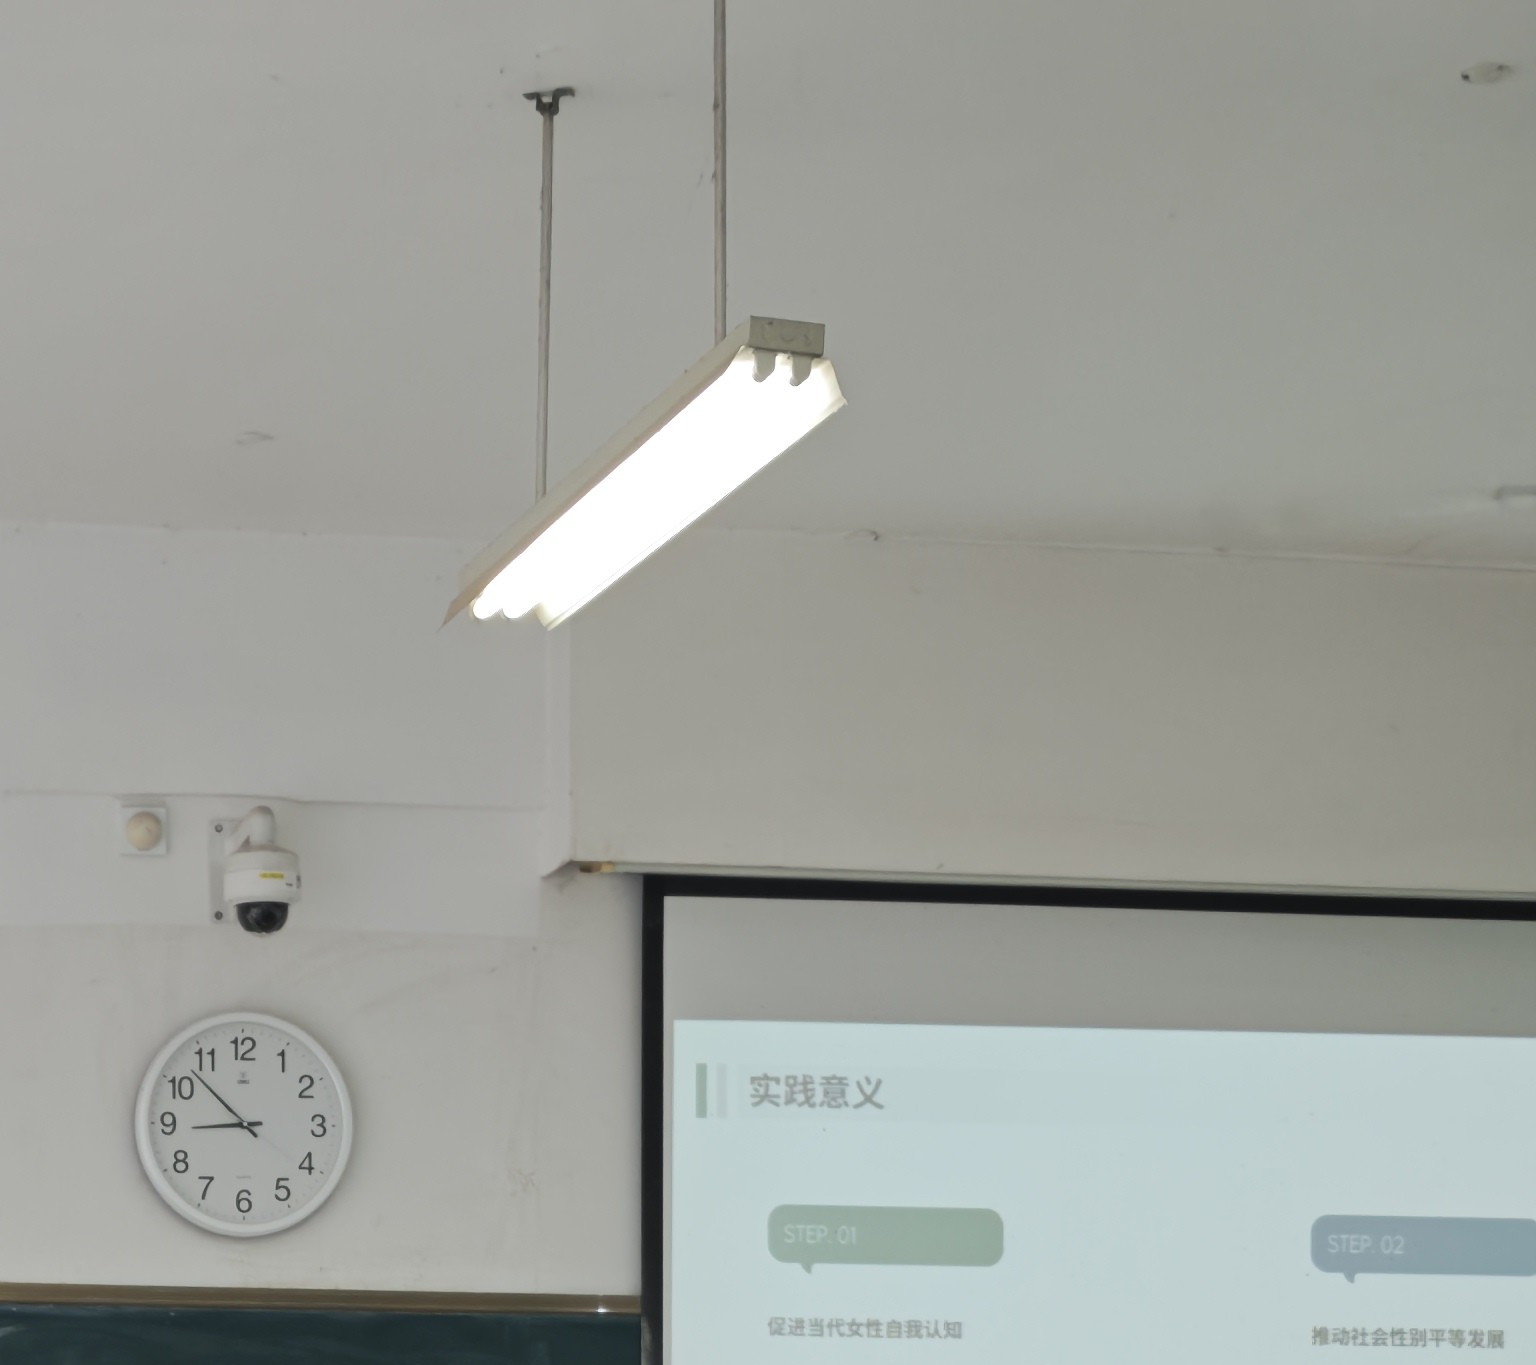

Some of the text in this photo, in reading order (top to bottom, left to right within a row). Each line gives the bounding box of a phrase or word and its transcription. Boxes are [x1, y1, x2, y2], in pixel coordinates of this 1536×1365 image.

[194, 1048, 215, 1071] 11
[230, 1036, 257, 1061] 12
[276, 1049, 286, 1073] 1
[168, 1076, 194, 1100] 10
[298, 1075, 315, 1099] 2
[749, 1073, 885, 1110] 实践意义
[160, 1111, 177, 1135] 9
[310, 1114, 327, 1137] 3
[172, 1150, 189, 1174] 8
[298, 1152, 315, 1175] 4
[198, 1176, 215, 1200] 7
[274, 1177, 291, 1201] 5
[235, 1189, 252, 1213] 6
[837, 1225, 857, 1245] 01
[1380, 1235, 1405, 1254] 02
[768, 1317, 963, 1340] 促进当代女性自我认知
[1312, 1326, 1505, 1349] 推动社会性别平等发展
